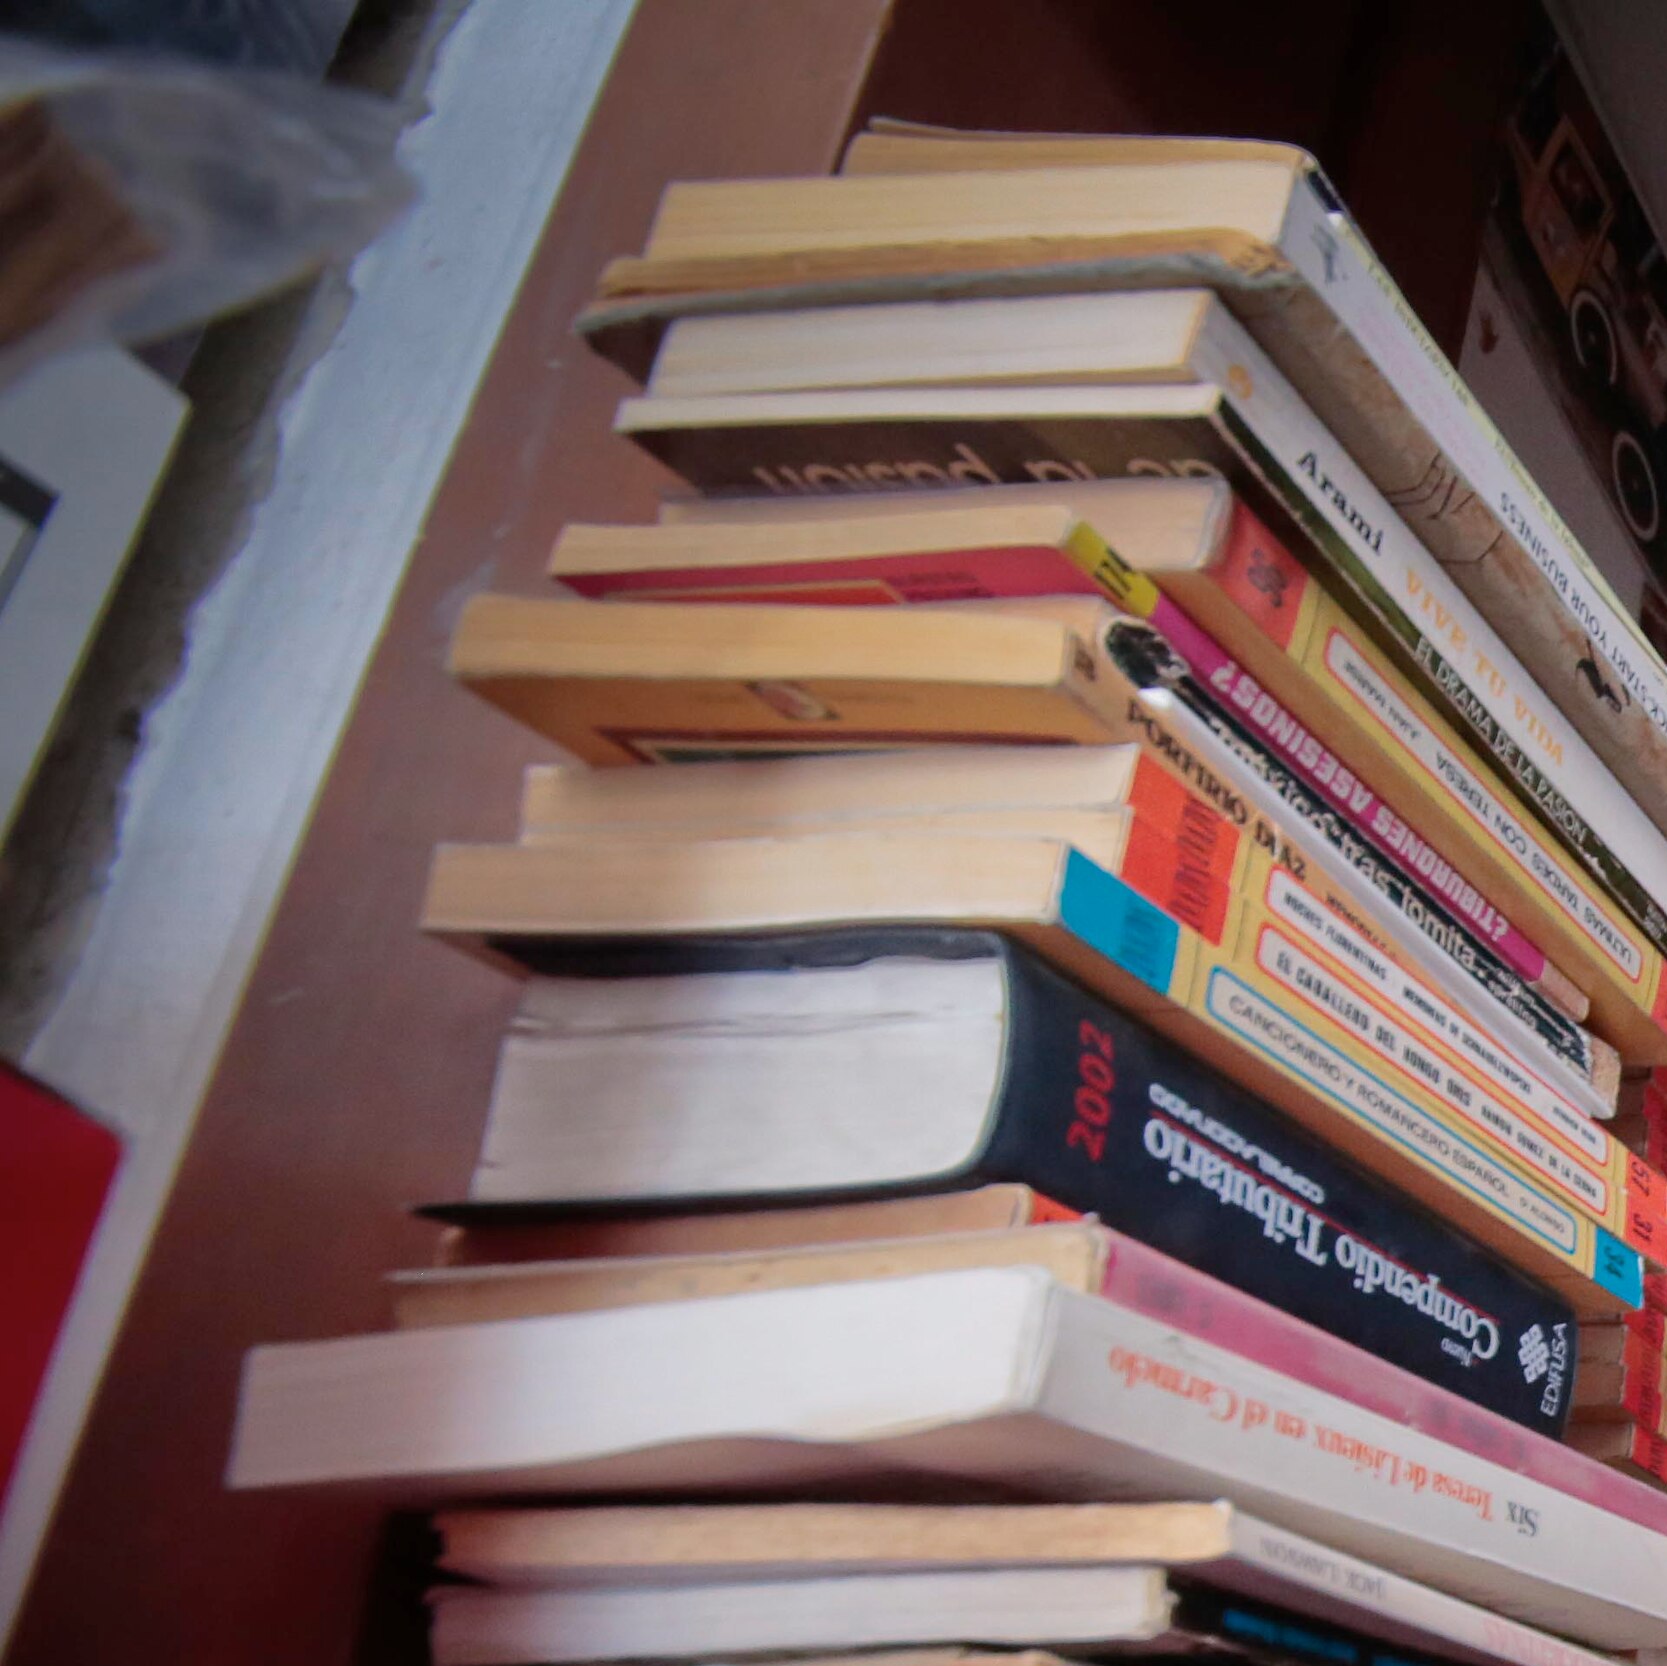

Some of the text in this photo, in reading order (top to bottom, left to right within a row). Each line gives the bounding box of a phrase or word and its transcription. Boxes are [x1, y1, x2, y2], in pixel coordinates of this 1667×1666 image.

[1297, 451, 1386, 554] Arami
[1498, 492, 1569, 592] BUSINESS
[1402, 566, 1566, 765] VIVE TU VIDA
[1410, 639, 1498, 735] EL DRAMA
[1433, 751, 1633, 963] ULTIMAS TARDES CON TERESA
[1066, 1018, 1119, 1161] 2002
[1228, 996, 1343, 1082] CANCIONERO
[1356, 1084, 1450, 1155] ROMANCERO
[1130, 1116, 1512, 1363] Compendio Tributario
[1100, 1346, 1543, 1538] Six Teresa de Lisieux en el Carmelo
[1539, 1322, 1565, 1416] EDIFUSA
